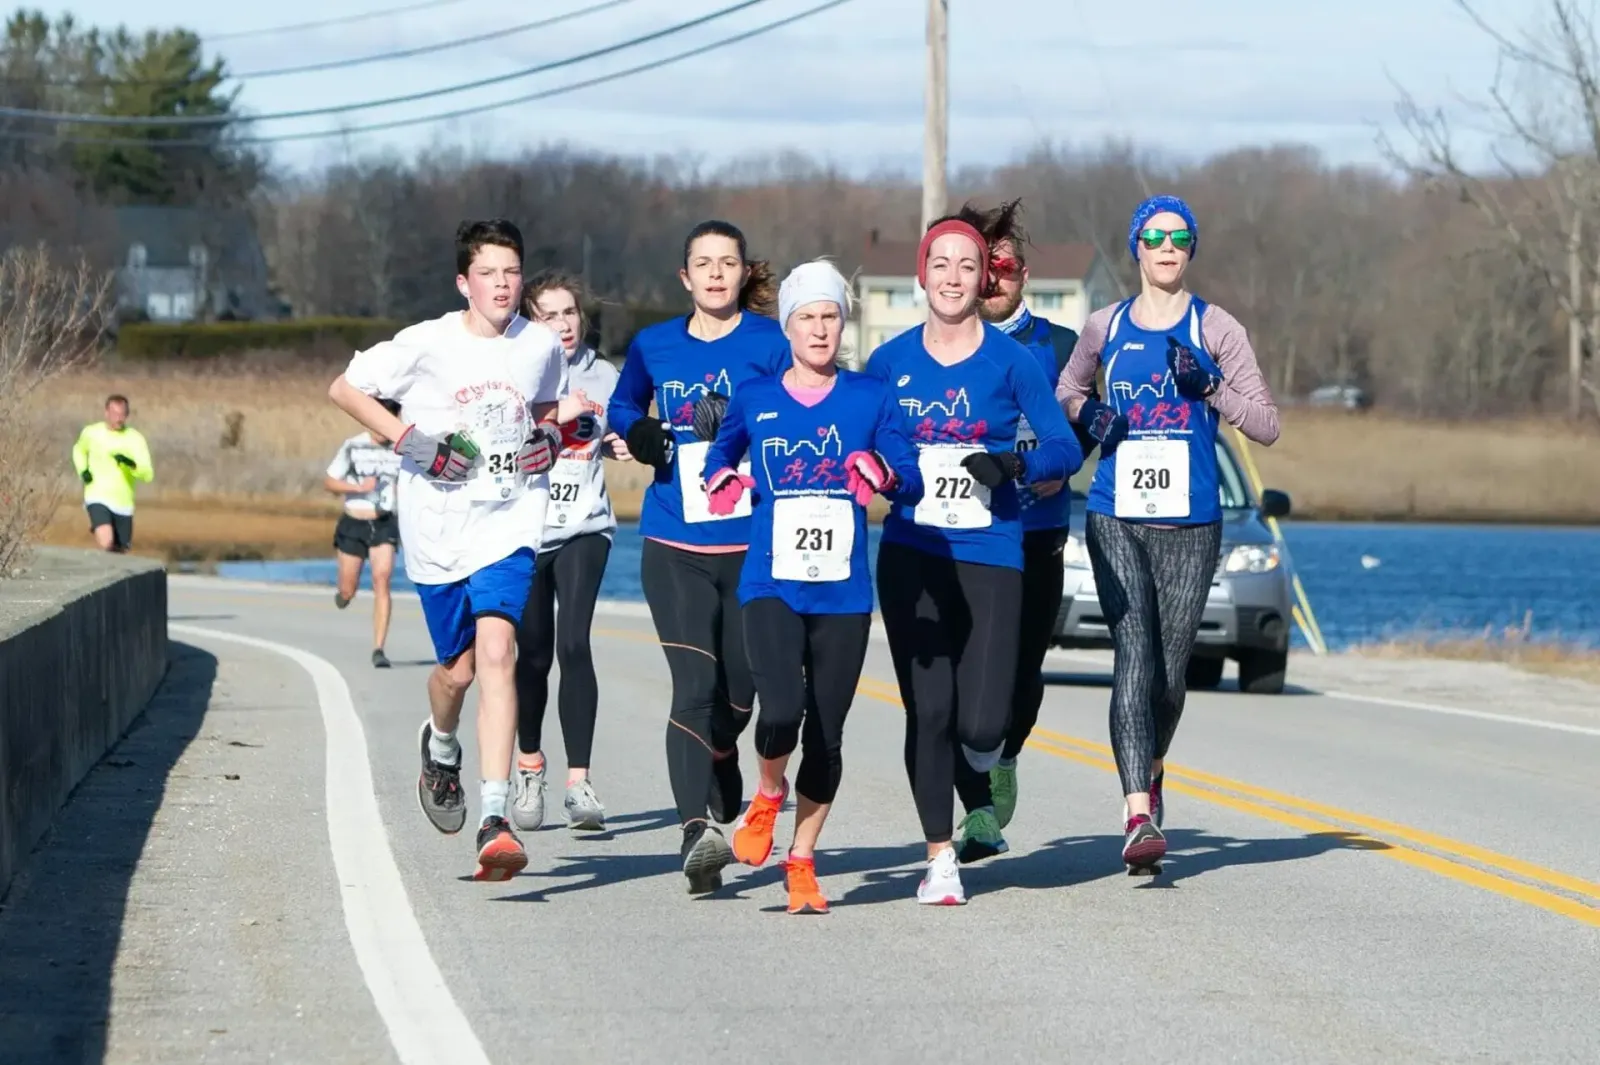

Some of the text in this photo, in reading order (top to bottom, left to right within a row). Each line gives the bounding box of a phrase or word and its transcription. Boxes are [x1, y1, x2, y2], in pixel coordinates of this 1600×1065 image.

[489, 452, 518, 474] 34
[935, 477, 971, 499] 272
[1132, 468, 1170, 489] 230
[795, 527, 833, 551] 231
